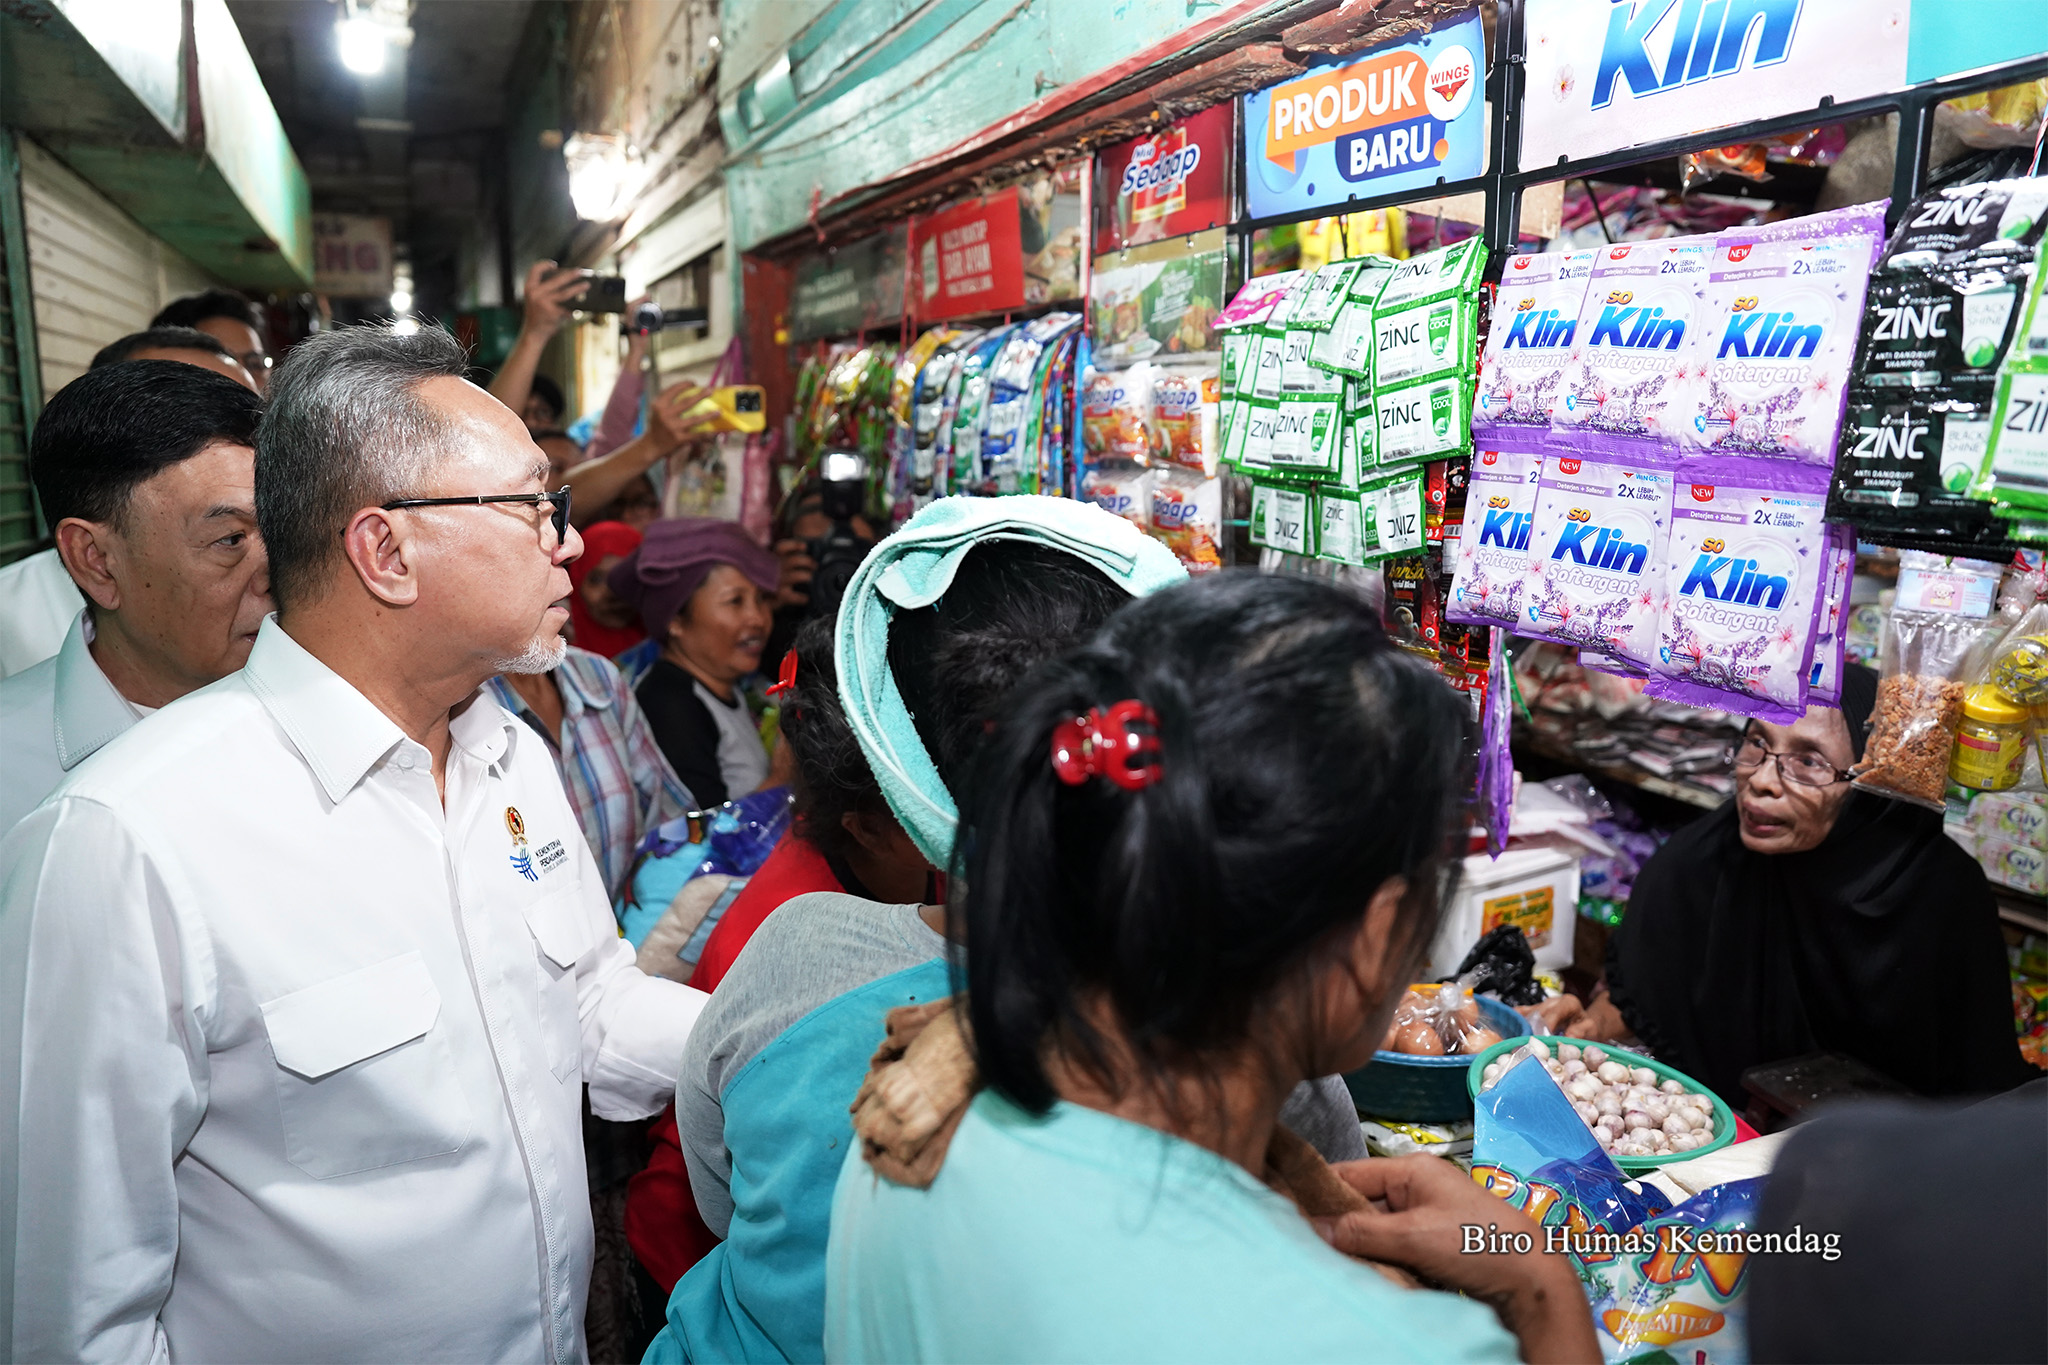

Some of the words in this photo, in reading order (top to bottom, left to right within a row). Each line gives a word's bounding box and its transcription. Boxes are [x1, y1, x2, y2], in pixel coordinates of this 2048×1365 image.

[1591, 0, 1803, 110] Klin
[1430, 65, 1470, 85] WINGS
[1274, 61, 1418, 140] PRODUK
[1350, 122, 1431, 176] BARU
[1122, 146, 1198, 194] Sedaap
[1910, 195, 2001, 229] ZINC
[1612, 248, 1630, 257] NEW
[1729, 248, 1750, 258] NEW
[1394, 259, 1438, 281] ZINC
[1571, 271, 1592, 279] LEMBU
[1517, 297, 1535, 311] SO
[1606, 290, 1633, 305] SO
[1732, 296, 1758, 312] SO
[1429, 318, 1451, 330] COOL
[1503, 309, 1577, 349] Klin
[1589, 306, 1687, 351] Klin
[1873, 304, 1952, 341] ZINC
[1380, 322, 1420, 352] ZINC
[1716, 312, 1824, 361] Klin
[1261, 350, 1282, 369] ZIN
[1286, 344, 1308, 362] ZIN
[1498, 351, 1568, 371] Softergent
[1583, 349, 1675, 374] Softergent
[1712, 362, 1811, 388] Softergent
[1432, 398, 1452, 410] COOL
[1276, 415, 1307, 434] ZINC
[1382, 401, 1421, 429] ZINC
[1250, 420, 1276, 440] ZIN
[1853, 426, 1929, 460] ZINC
[1484, 453, 1497, 463] NEW
[1561, 462, 1580, 471] NEW
[1556, 482, 1579, 491] Deterjen
[1585, 486, 1606, 495] Softener
[1693, 488, 1713, 498] NEW
[1487, 496, 1510, 509] SO
[1567, 507, 1591, 523] SO
[1690, 511, 1714, 520] Deterjen
[1720, 513, 1742, 522] Softener
[1275, 518, 1299, 540] ZINC
[1387, 513, 1416, 539] ZINC
[1479, 509, 1533, 551] Kli
[1551, 521, 1649, 576] Klin
[1700, 537, 1725, 554] SO
[1475, 549, 1527, 574] Softerge
[1545, 563, 1639, 596] Softergent
[1679, 554, 1789, 612] Klin
[1674, 599, 1779, 633] Softergent
[1599, 624, 1613, 636] 21
[1735, 664, 1750, 678] 21
[2007, 807, 2043, 828] Giv
[2007, 850, 2042, 871] Giv
